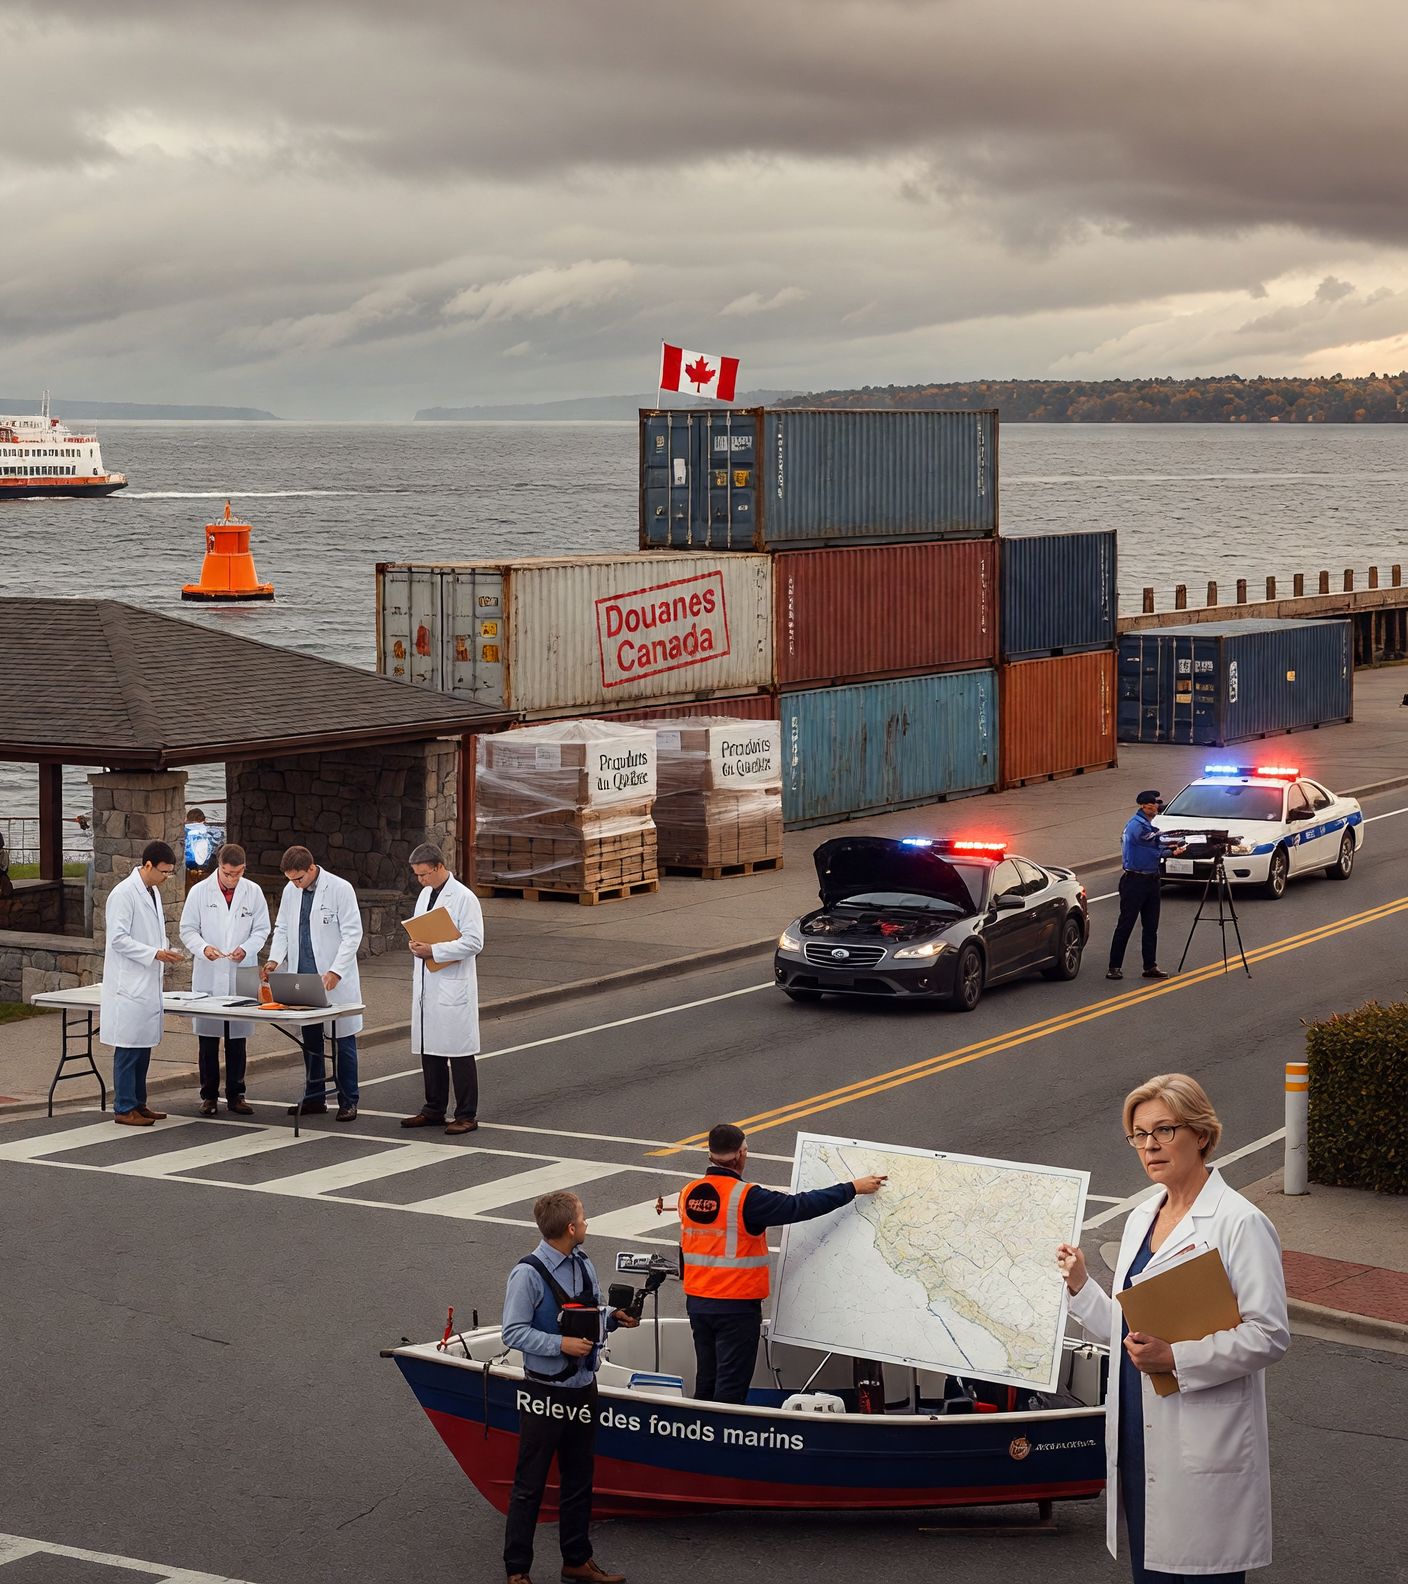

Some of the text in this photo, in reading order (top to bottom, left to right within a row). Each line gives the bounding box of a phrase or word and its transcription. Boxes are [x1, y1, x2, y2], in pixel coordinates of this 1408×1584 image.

[606, 588, 716, 638] Douanes
[617, 622, 713, 672] Canada
[516, 1389, 804, 1451] Relevé des fonds marins
